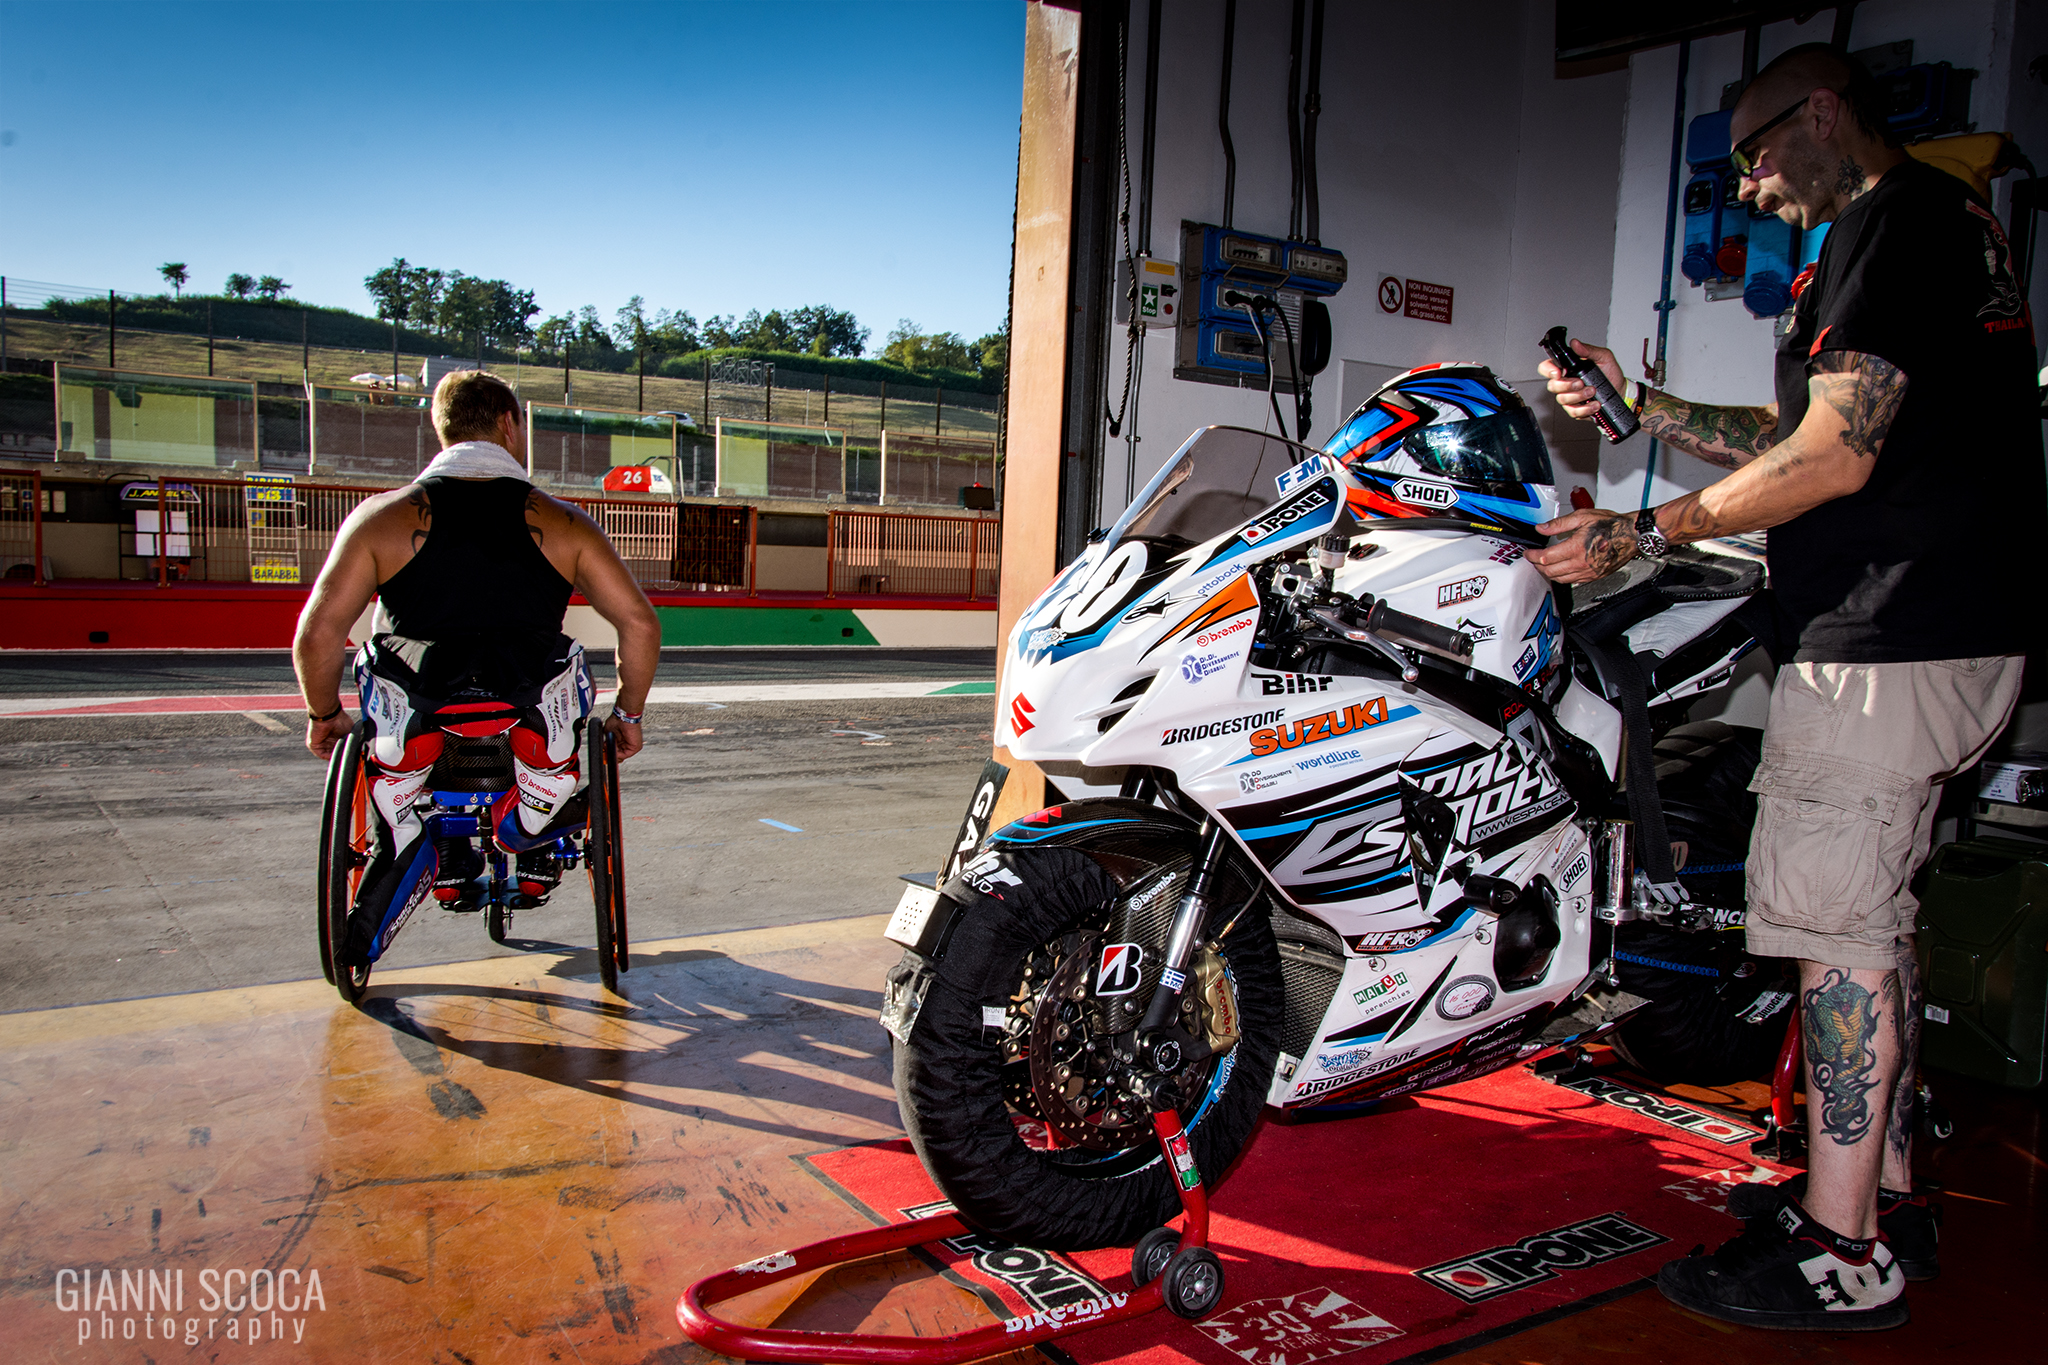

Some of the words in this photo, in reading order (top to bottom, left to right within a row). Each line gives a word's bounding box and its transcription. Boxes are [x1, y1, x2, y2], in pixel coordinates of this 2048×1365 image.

[1408, 282, 1421, 290] NON
[1142, 306, 1157, 315] Stop
[1984, 317, 2026, 333] THAILA
[623, 471, 642, 484] 26
[1277, 455, 1322, 492] FFM
[140, 489, 177, 498] ANEL
[1402, 484, 1449, 504] SHOEI
[251, 512, 262, 525] P
[1257, 491, 1329, 534] IPONE
[254, 569, 298, 579] BARABBA
[1439, 581, 1474, 603] HFR
[1209, 618, 1253, 643] brembo
[1468, 626, 1497, 641] HOME
[1251, 673, 1333, 696] Bihr
[1249, 696, 1390, 756] SUZUKI
[1295, 748, 1361, 772] worldline
[404, 784, 424, 800] brem
[528, 779, 557, 798] brembo
[962, 870, 993, 893] EVO
[1562, 856, 1587, 888] SHOEI
[1142, 872, 1177, 904] brembo
[1361, 932, 1406, 946] HFR
[1353, 972, 1408, 1005] MATCH
[1216, 979, 1233, 1034] brembo
[1365, 990, 1411, 1015] perenchies
[1295, 1047, 1421, 1098] BRIDGESTONE
[1569, 1078, 1706, 1127] IPON
[1481, 1213, 1645, 1288] IPONE
[1244, 1310, 1311, 1341] 30
[1275, 1333, 1331, 1352] YEARS
